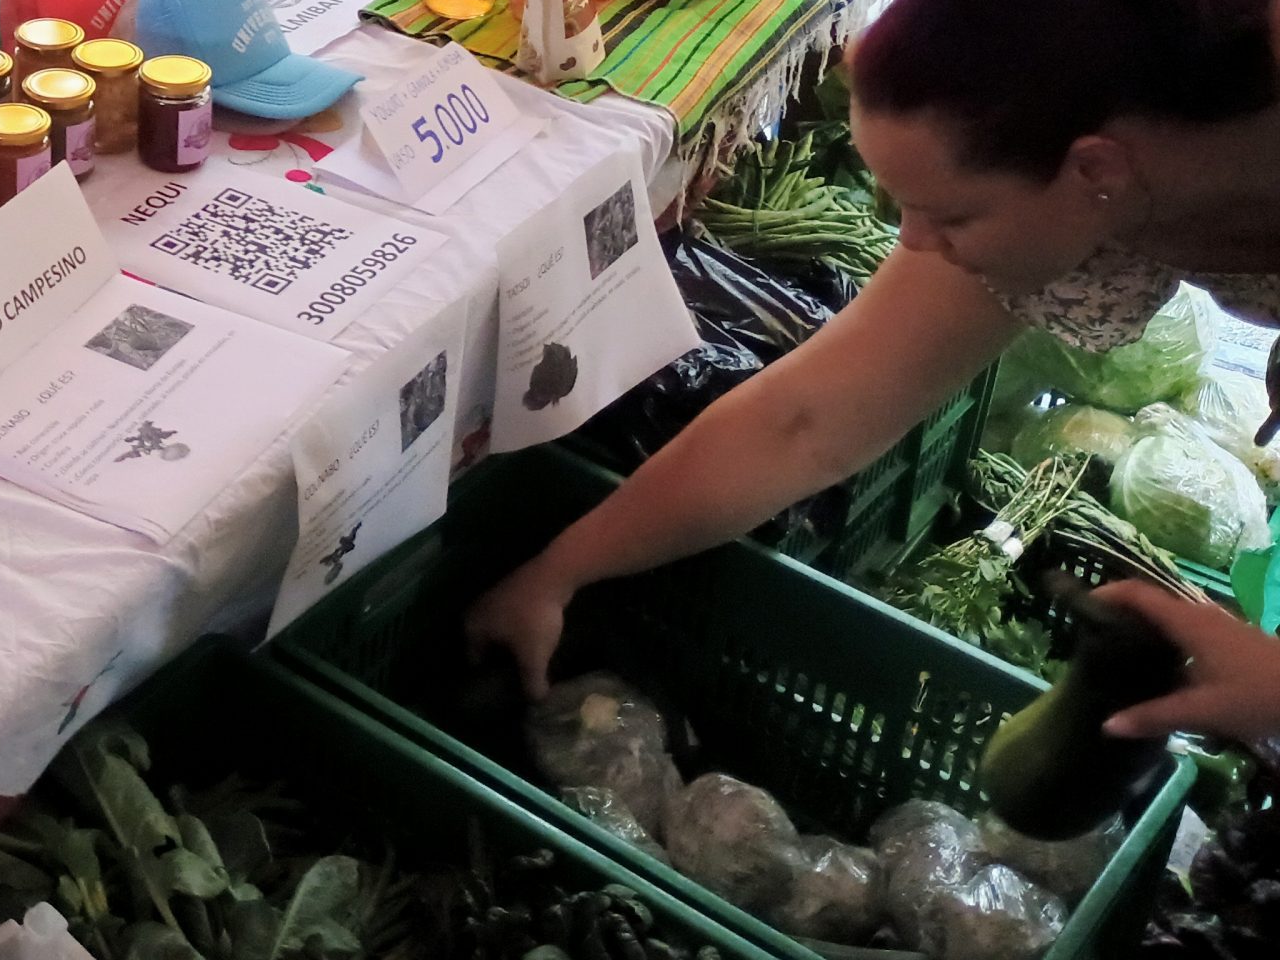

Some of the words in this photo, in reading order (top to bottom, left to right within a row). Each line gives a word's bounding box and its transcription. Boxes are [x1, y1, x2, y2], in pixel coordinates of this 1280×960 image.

[411, 83, 489, 164] 5.000
[121, 182, 188, 226] NEQUI
[3, 245, 88, 321] CAMPESINO
[297, 233, 418, 326] 3008059826
